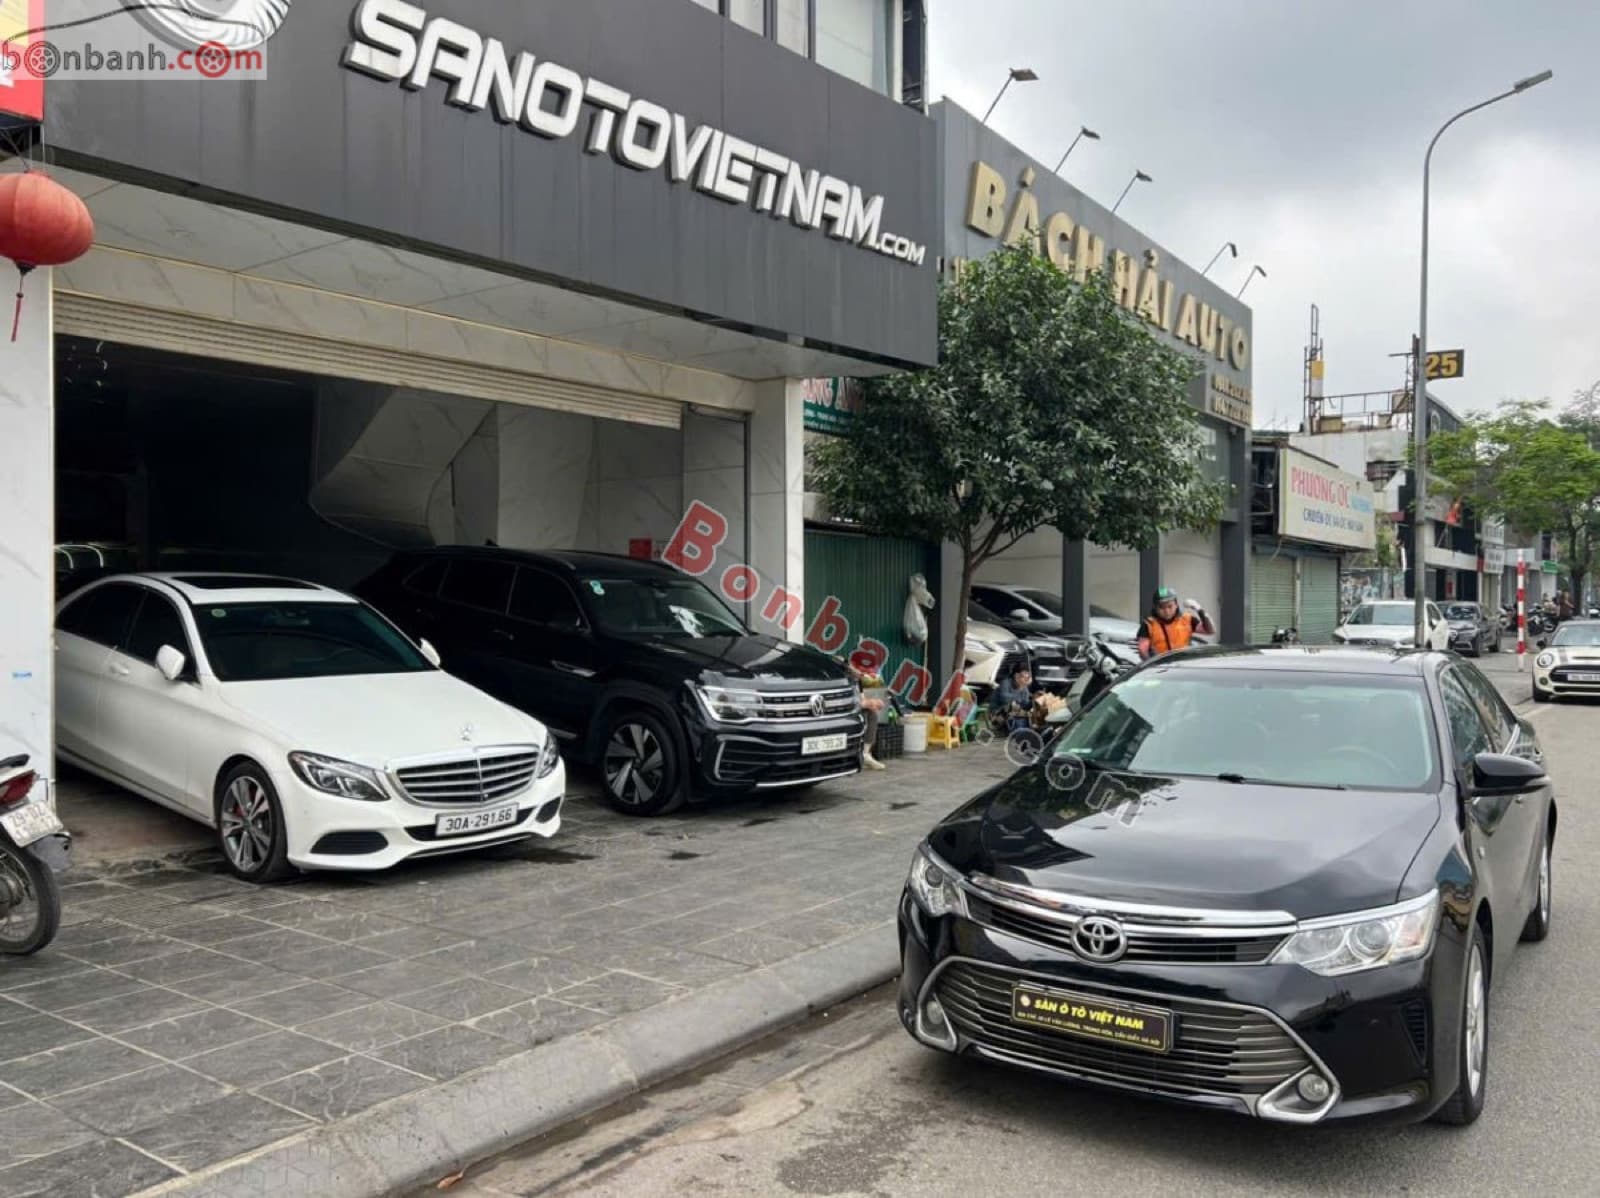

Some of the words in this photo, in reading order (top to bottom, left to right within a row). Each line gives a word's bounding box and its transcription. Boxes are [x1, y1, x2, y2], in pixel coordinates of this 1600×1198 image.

[1175, 292, 1249, 371] AUTO
[445, 808, 512, 832] 30A-291.66
[1115, 1016, 1144, 1030] NAM
